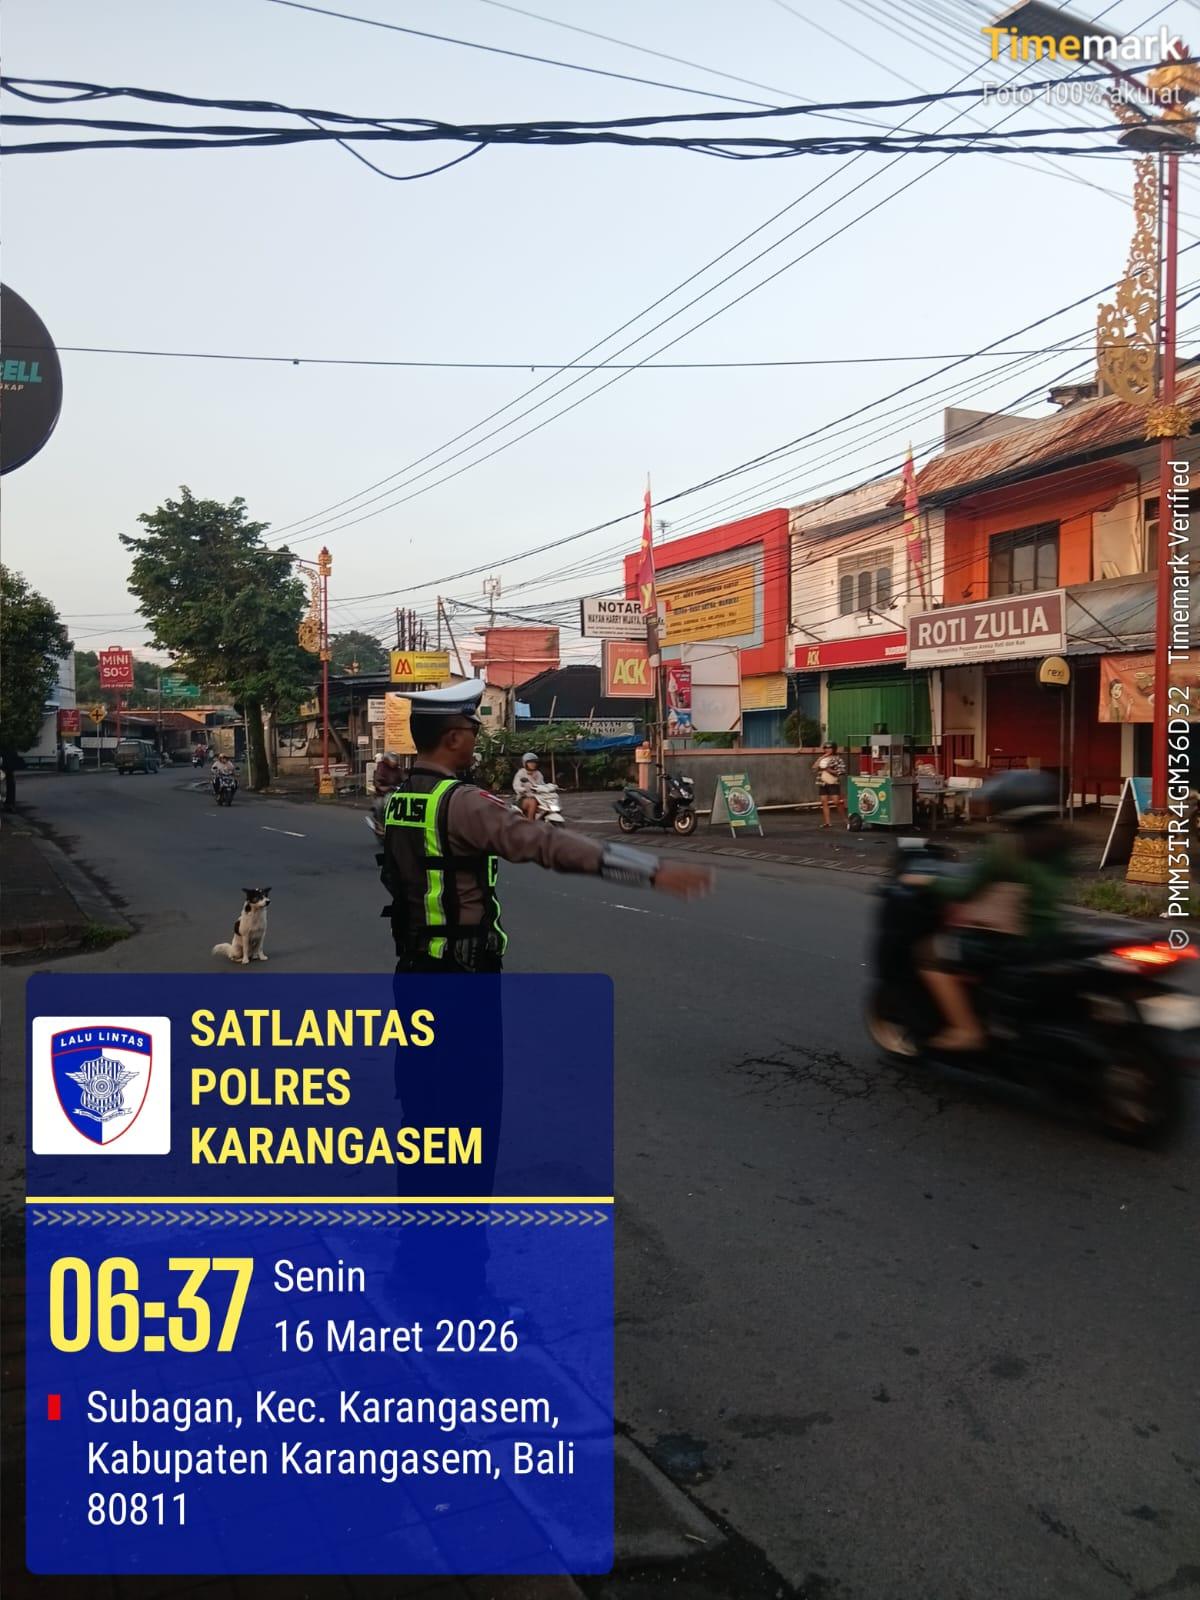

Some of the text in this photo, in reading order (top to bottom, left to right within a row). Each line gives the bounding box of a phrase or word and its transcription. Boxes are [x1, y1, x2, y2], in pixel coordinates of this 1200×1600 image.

[598, 601, 642, 614] NOTAR
[918, 606, 1049, 647] ROTI ZULIA
[102, 655, 129, 665] MINI
[807, 650, 820, 666] ACK
[613, 658, 647, 684] ACK
